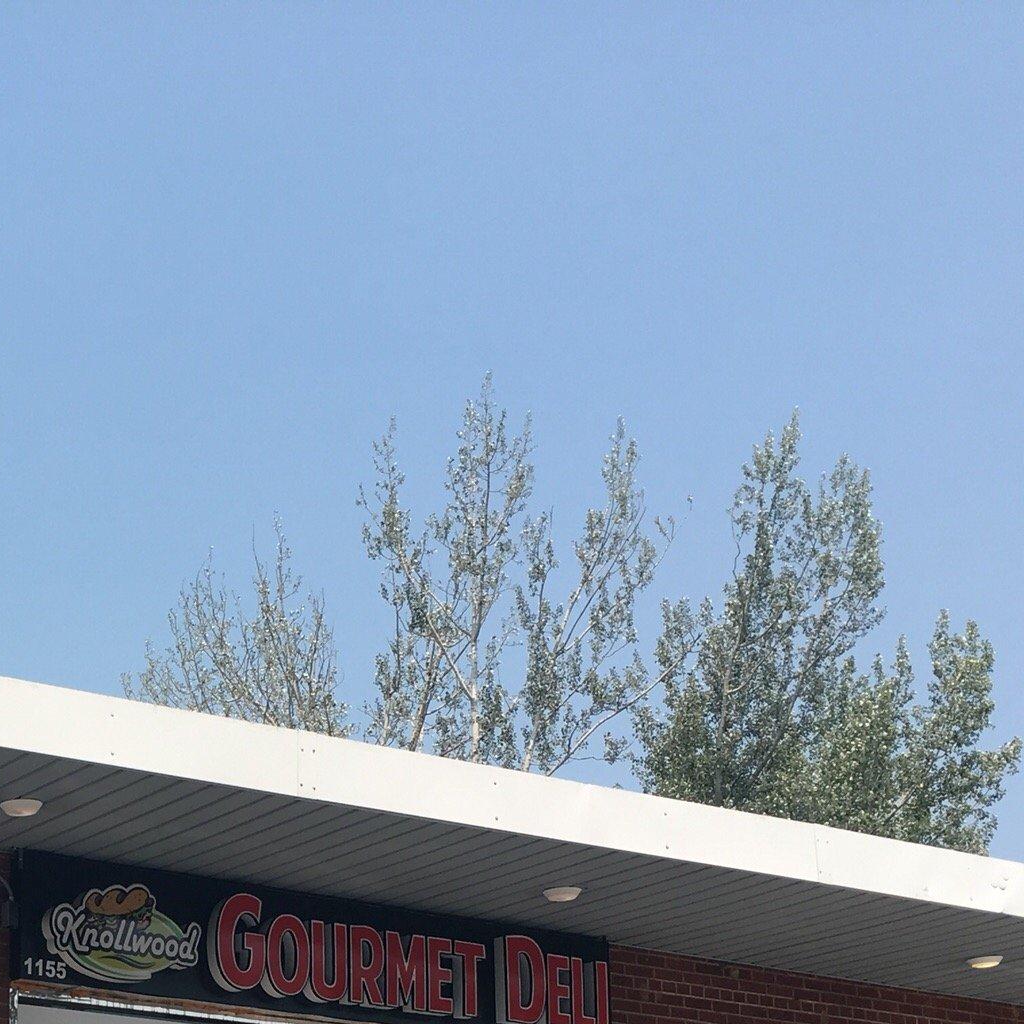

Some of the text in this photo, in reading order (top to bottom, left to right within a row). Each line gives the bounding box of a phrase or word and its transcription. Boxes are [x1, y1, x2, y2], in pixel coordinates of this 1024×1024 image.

[23, 956, 67, 980] 1155
[55, 911, 199, 963] Knollwood
[215, 892, 486, 1018] GOURMET
